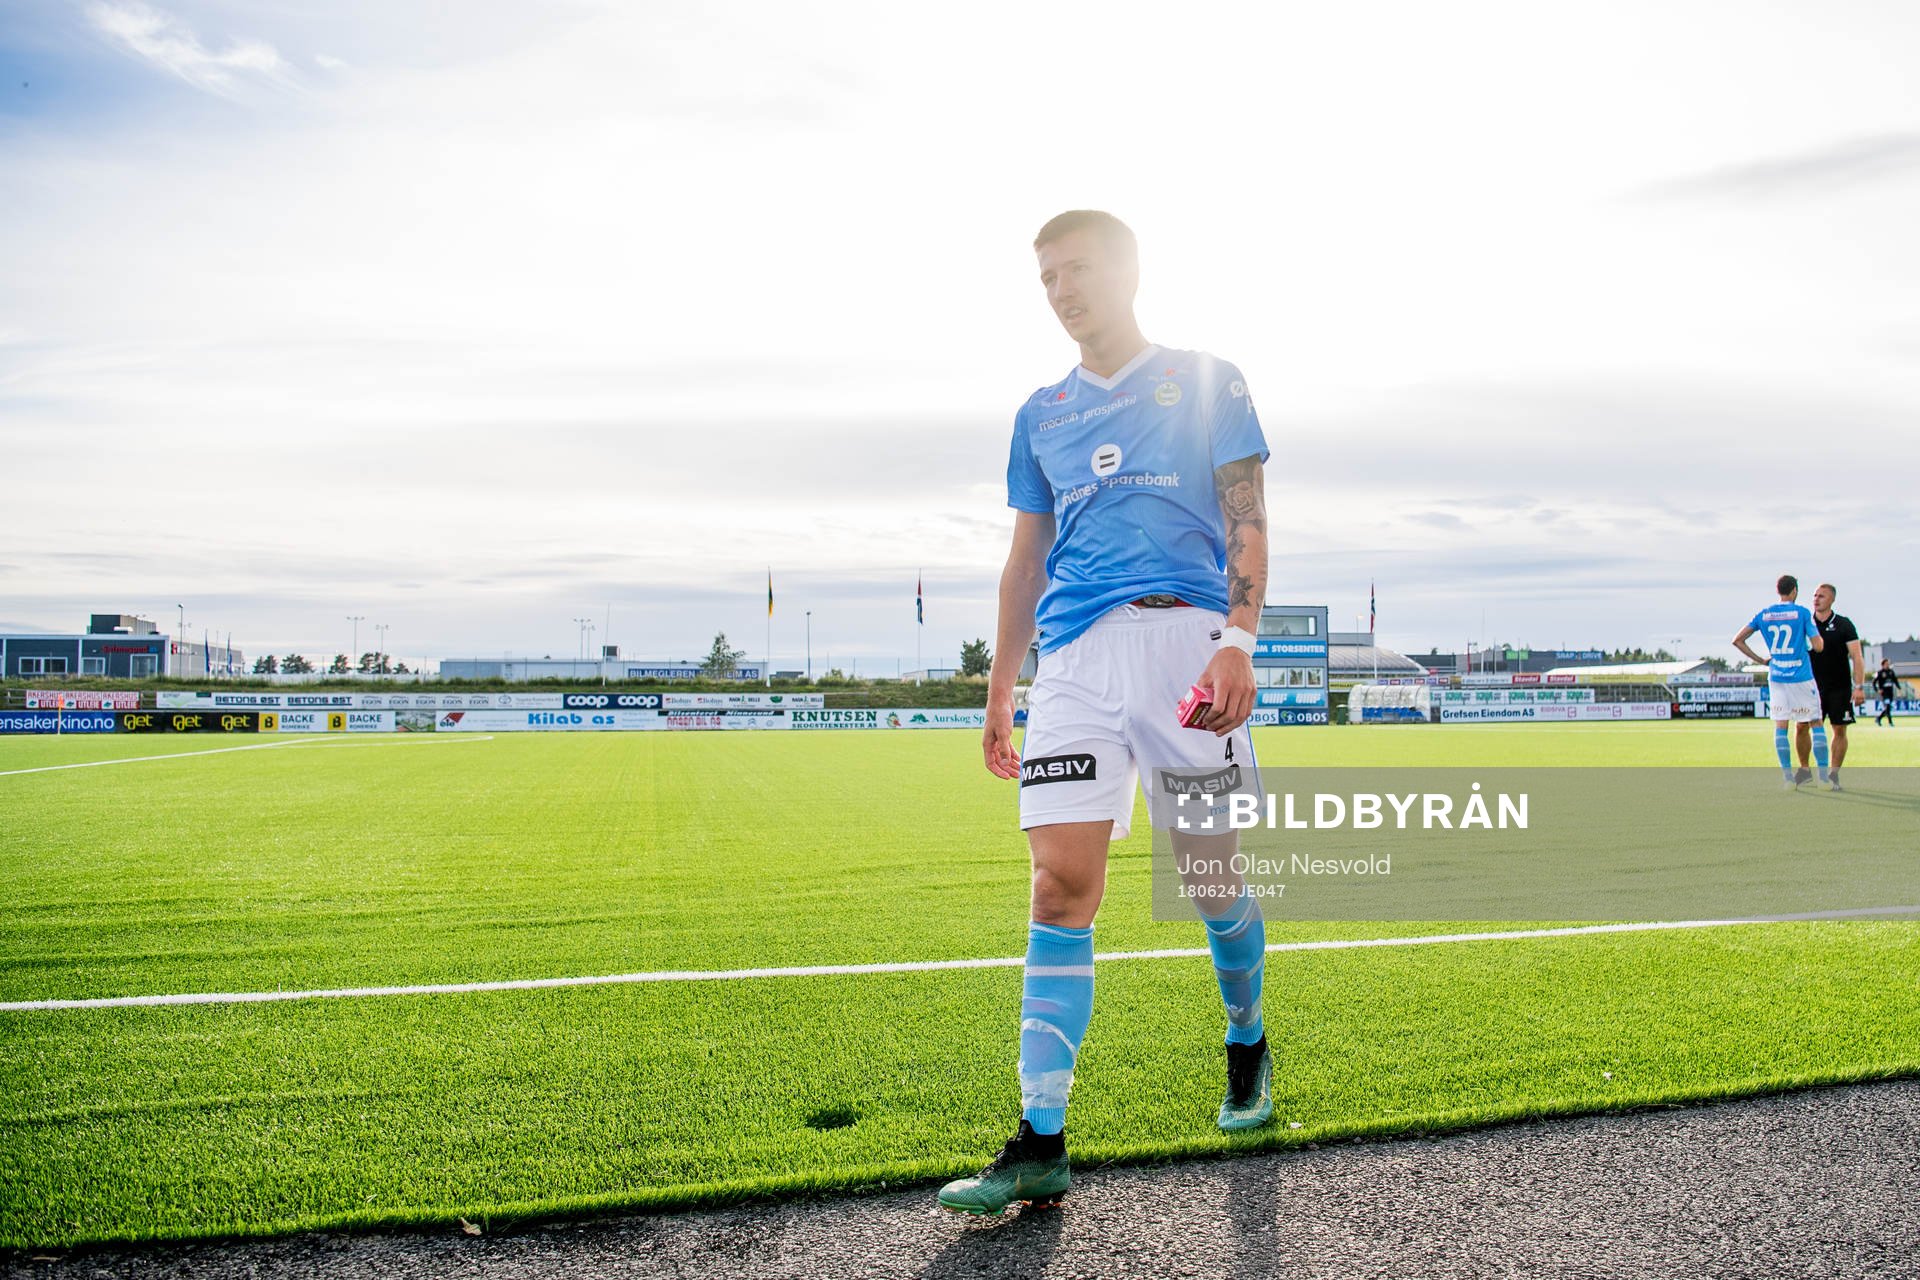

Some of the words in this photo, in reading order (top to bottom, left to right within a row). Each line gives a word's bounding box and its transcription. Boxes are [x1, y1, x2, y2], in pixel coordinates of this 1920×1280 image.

[1039, 412, 1079, 432] macron
[1083, 395, 1137, 424] prosjektil
[1101, 472, 1180, 488] Sparebank
[1768, 624, 1795, 655] 22
[1272, 645, 1326, 653] STORSENTER
[630, 670, 696, 679] BILMEGLEREN
[745, 670, 759, 679] AS
[66, 691, 101, 700] AKERSHUS
[103, 692, 138, 700] AKERSHUS
[1694, 691, 1731, 700] ELEKTRO
[78, 701, 100, 709] UTLEIE
[115, 701, 137, 709] UTLEIE
[567, 695, 609, 708] coop
[617, 695, 659, 708] coop
[1673, 703, 1708, 712] Comfort
[792, 711, 877, 721] KNUTSEN
[1296, 713, 1327, 722] OBOS
[1442, 709, 1479, 718] Grefsen
[1481, 708, 1521, 717] Eiendom
[1522, 708, 1535, 717] AS
[281, 714, 315, 723] BACKE
[349, 714, 382, 723] BACKE
[528, 712, 582, 724] Kilab
[592, 715, 615, 724] as
[933, 714, 970, 723] Aurskog
[1225, 737, 1234, 762] 4
[1022, 759, 1091, 781] MASIV
[1166, 769, 1239, 795] MASIV
